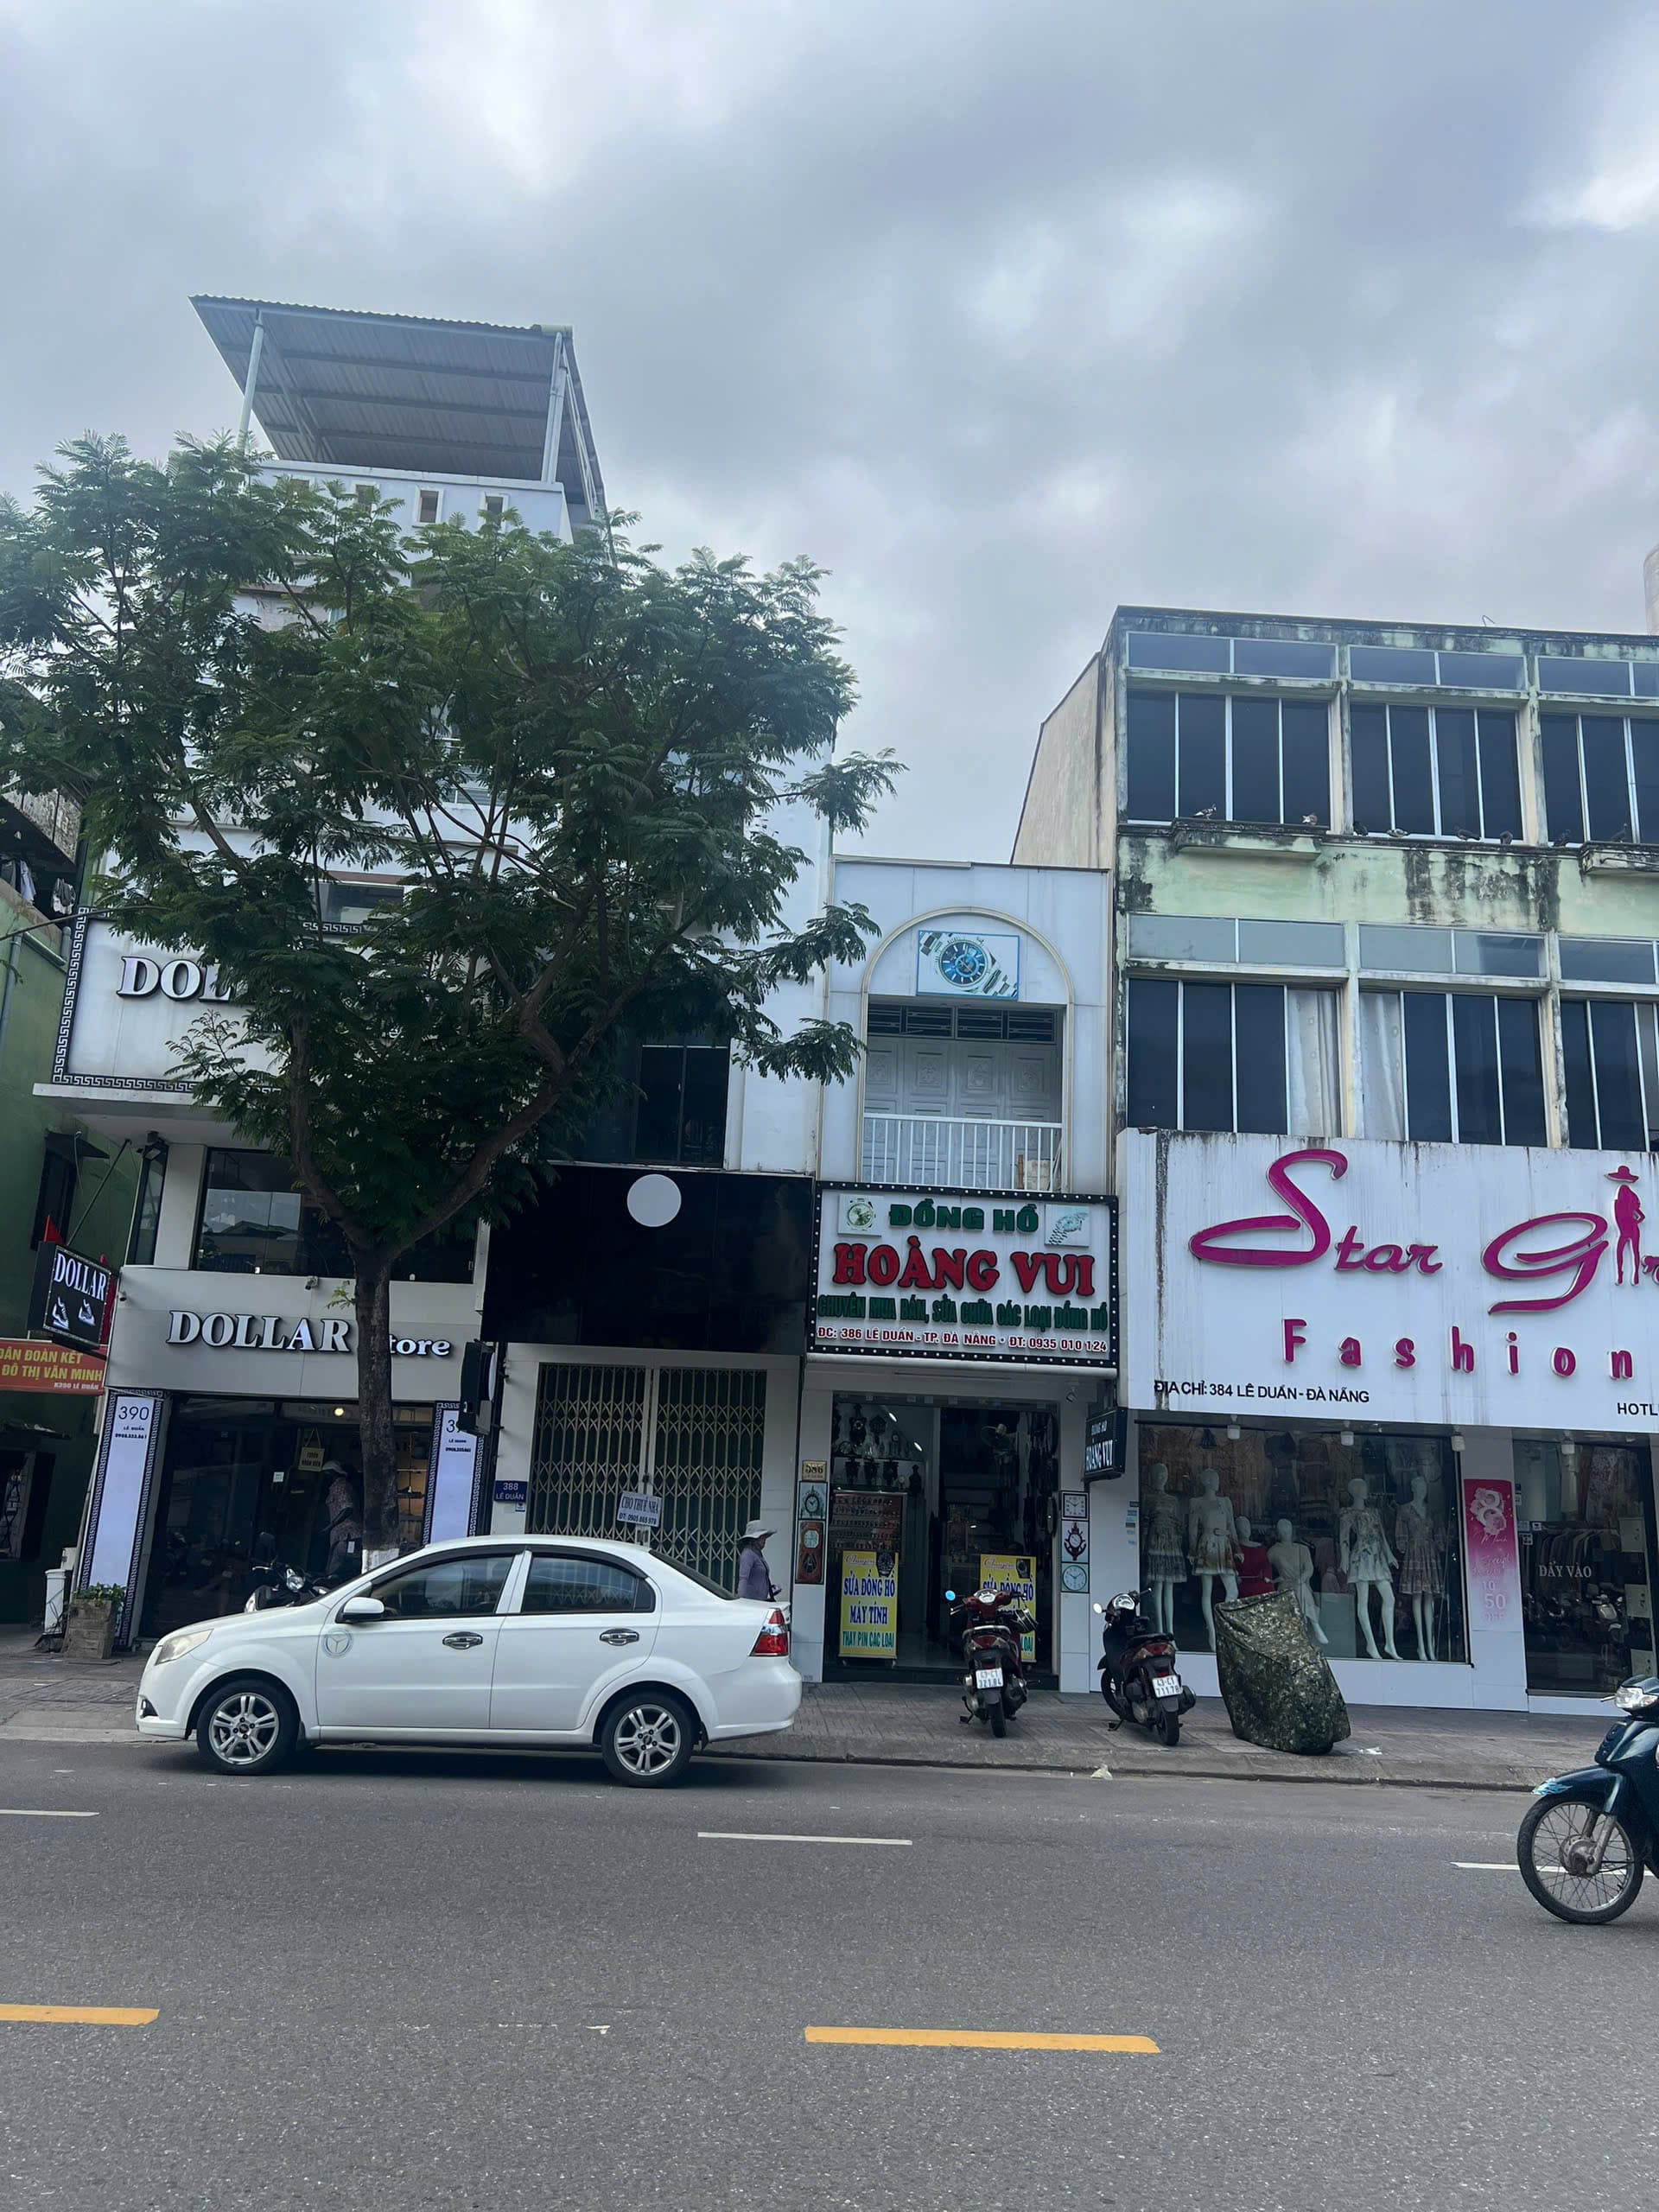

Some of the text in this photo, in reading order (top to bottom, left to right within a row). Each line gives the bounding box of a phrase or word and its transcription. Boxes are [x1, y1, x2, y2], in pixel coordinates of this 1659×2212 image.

[116, 956, 232, 1002] DOL
[1188, 1148, 1443, 1274] Star
[54, 1253, 107, 1301] DOLLAR
[832, 1235, 1096, 1296] HOÀNG VUI
[817, 1291, 866, 1318] CHUYÊN
[869, 1297, 896, 1319] MUA
[996, 1300, 1021, 1326] CÁC
[1024, 1305, 1052, 1332] LOẠI
[166, 1310, 451, 1357] DOLLAR tore
[817, 1326, 837, 1338] ĐC:
[841, 1328, 862, 1339] 386
[865, 1327, 879, 1340] LÊ
[924, 1332, 939, 1343] TP.
[943, 1331, 958, 1344] ĐÀ
[1008, 1336, 1026, 1348] ĐT:
[1029, 1338, 1057, 1349] 0935
[1060, 1339, 1082, 1351] 010
[1085, 1340, 1108, 1352] 124
[24, 1348, 58, 1363] ĐOÀN
[1282, 1318, 1634, 1381] Fashion
[2, 1363, 103, 1382] ĐÔ THỊ VĂN MINH
[1210, 1383, 1233, 1396] 384
[1237, 1382, 1254, 1397] LÊ
[1306, 1387, 1326, 1401] ĐÀ
[118, 1406, 149, 1421] 390
[1618, 1402, 1659, 1416] HOTL
[503, 1482, 518, 1491] 388
[1539, 1560, 1592, 1578] ĐẨY VÀO
[843, 1570, 859, 1595] SỬA
[850, 1601, 887, 1624] MÁY TÍNH
[1484, 1593, 1506, 1610] 50
[842, 1630, 856, 1646] THAY
[857, 1631, 868, 1647] PIN
